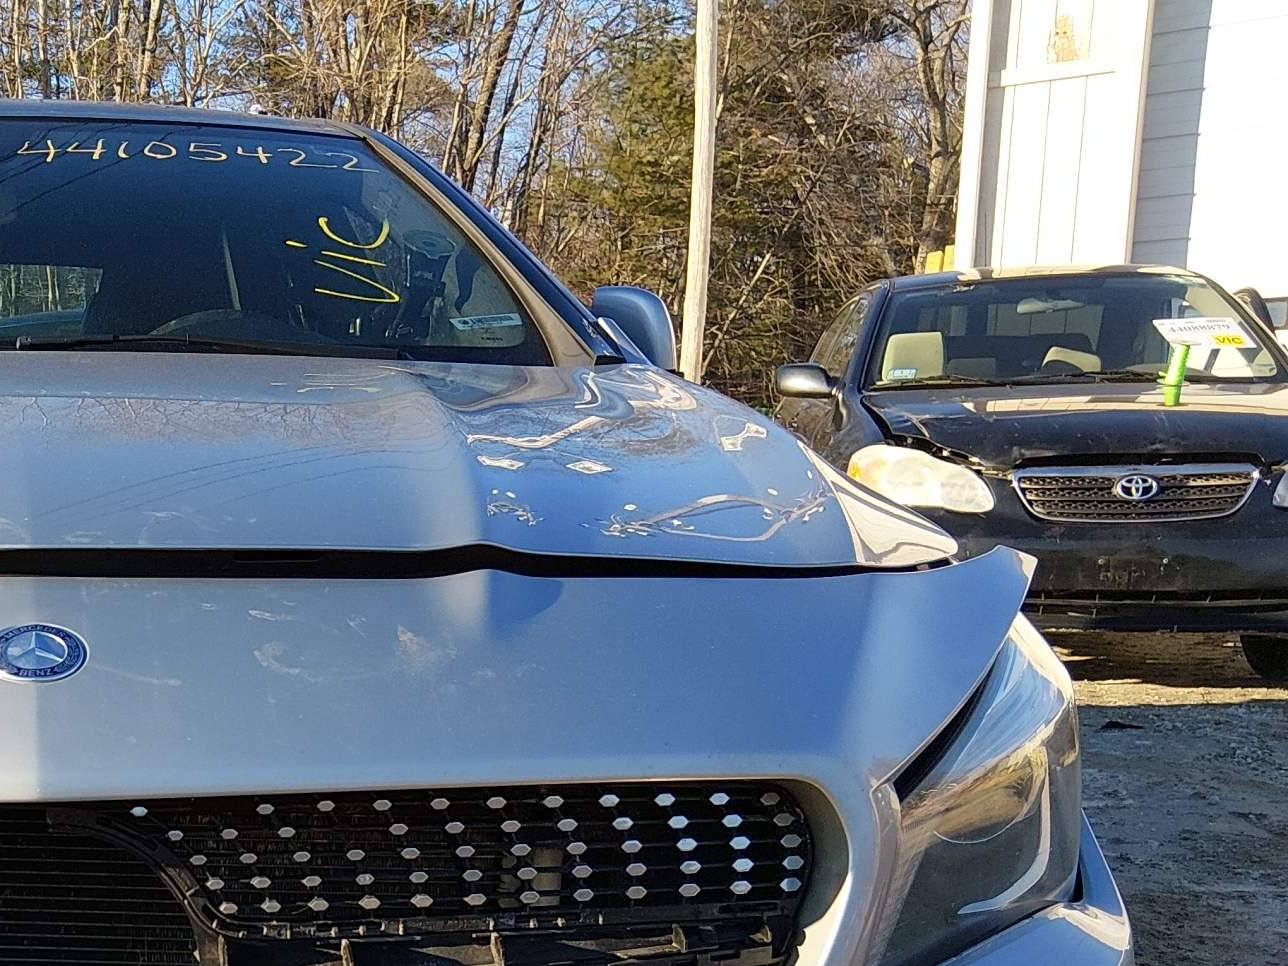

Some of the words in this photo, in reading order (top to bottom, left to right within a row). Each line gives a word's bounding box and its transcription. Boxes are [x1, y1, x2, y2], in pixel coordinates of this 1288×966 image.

[16, 138, 379, 173] 44105422
[1214, 336, 1244, 345] VIC
[18, 668, 54, 677] BENZ
